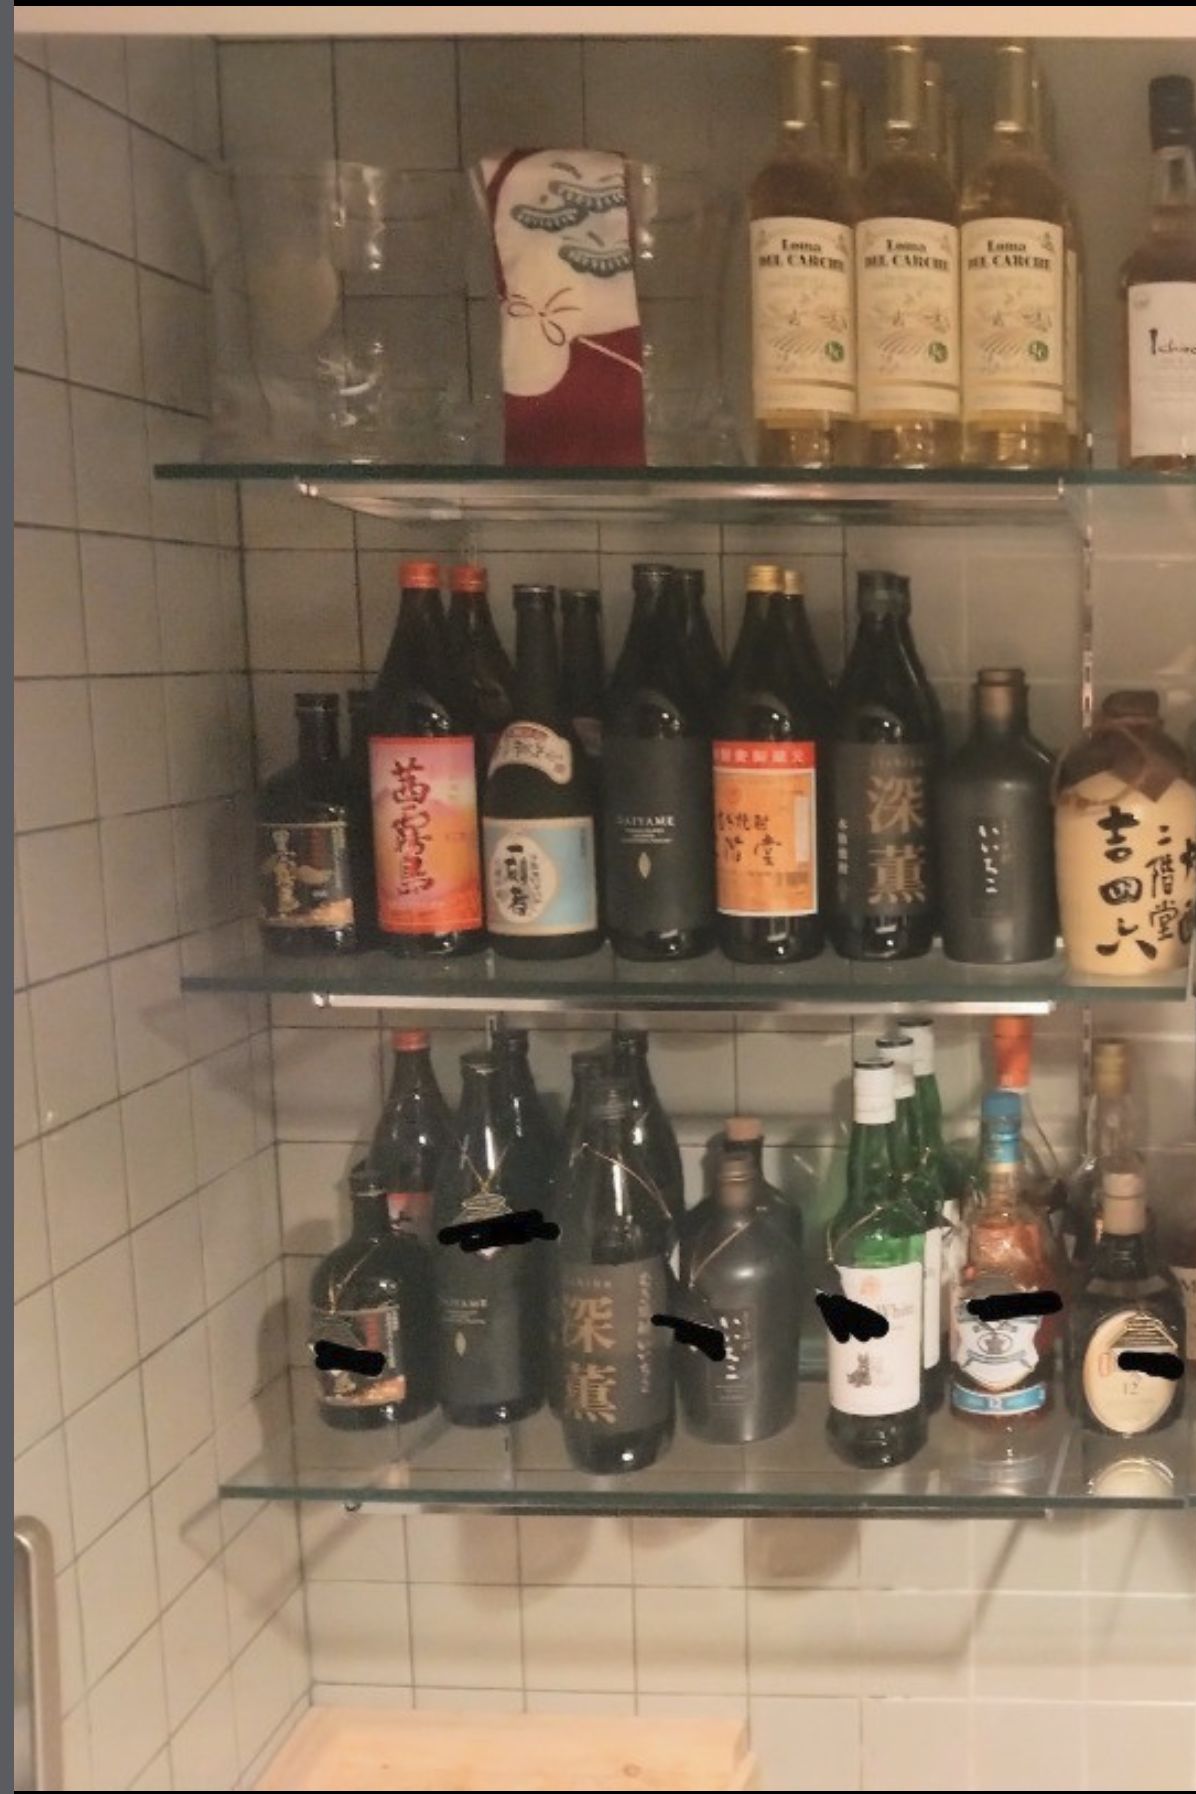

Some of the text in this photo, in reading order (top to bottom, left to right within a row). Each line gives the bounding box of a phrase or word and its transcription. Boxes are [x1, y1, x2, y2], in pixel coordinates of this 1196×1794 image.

[978, 824, 999, 893] いいちこ
[1096, 805, 1158, 960] 吉四六
